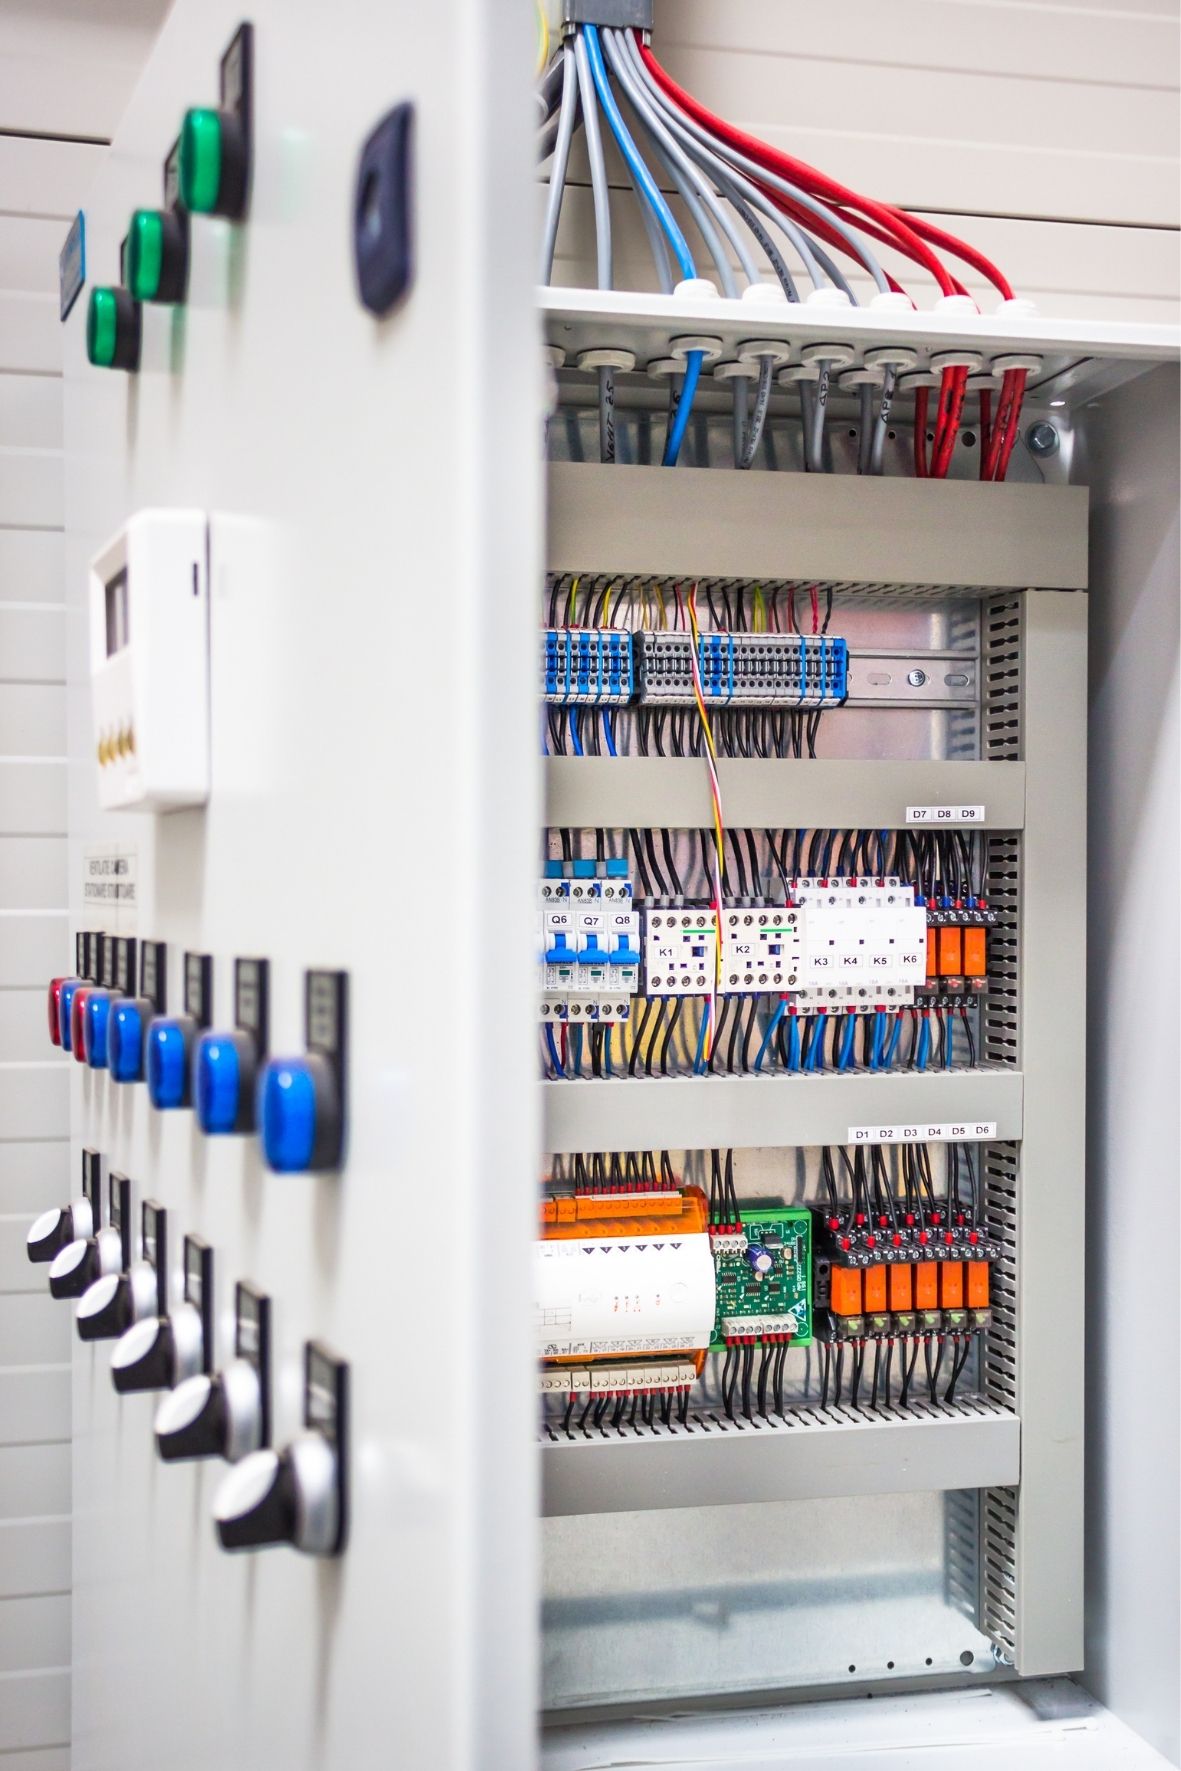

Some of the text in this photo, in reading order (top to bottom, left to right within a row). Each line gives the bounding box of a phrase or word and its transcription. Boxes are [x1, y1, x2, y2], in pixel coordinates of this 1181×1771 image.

[913, 809, 976, 819] D7 D8 D9
[551, 915, 568, 925] Q6
[583, 916, 600, 926] Q7
[614, 915, 631, 925] Q8
[659, 948, 674, 957] K1
[735, 945, 751, 954] K2
[813, 957, 829, 966] K3
[843, 956, 858, 966] K4
[873, 956, 888, 966] K5
[902, 954, 918, 964] K6
[855, 1125, 990, 1139] D1 D2 D3 D4 D5 D6
